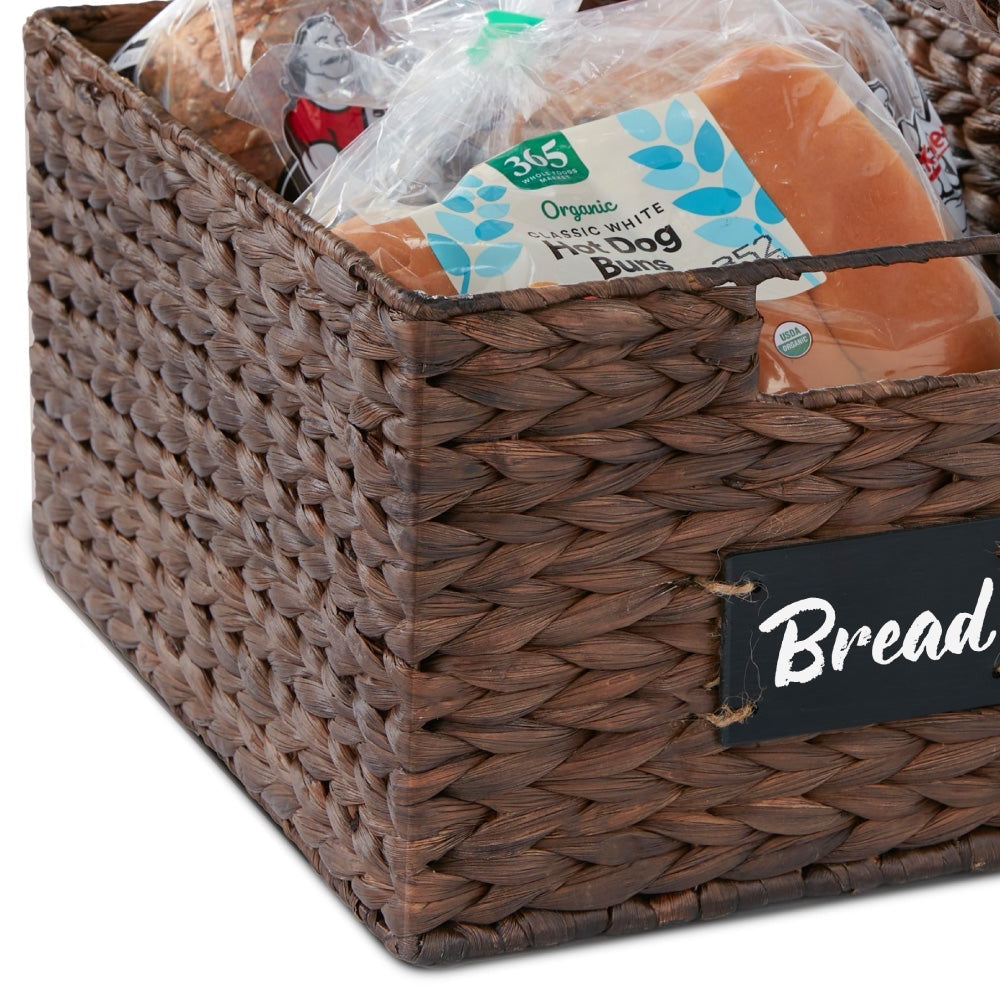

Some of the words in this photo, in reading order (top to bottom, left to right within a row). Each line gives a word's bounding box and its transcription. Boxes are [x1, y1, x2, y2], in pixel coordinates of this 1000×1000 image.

[504, 138, 568, 177] 365
[521, 170, 551, 185] WHOLE
[527, 226, 601, 240] CLASSIC
[604, 202, 665, 233] WHITE
[541, 199, 618, 222] Organic
[541, 238, 611, 261] Hot
[604, 224, 682, 254] Dog
[590, 256, 674, 280] Buns
[779, 327, 801, 342] USDA
[782, 336, 809, 352] ORGANIC
[758, 577, 997, 688] Bread
